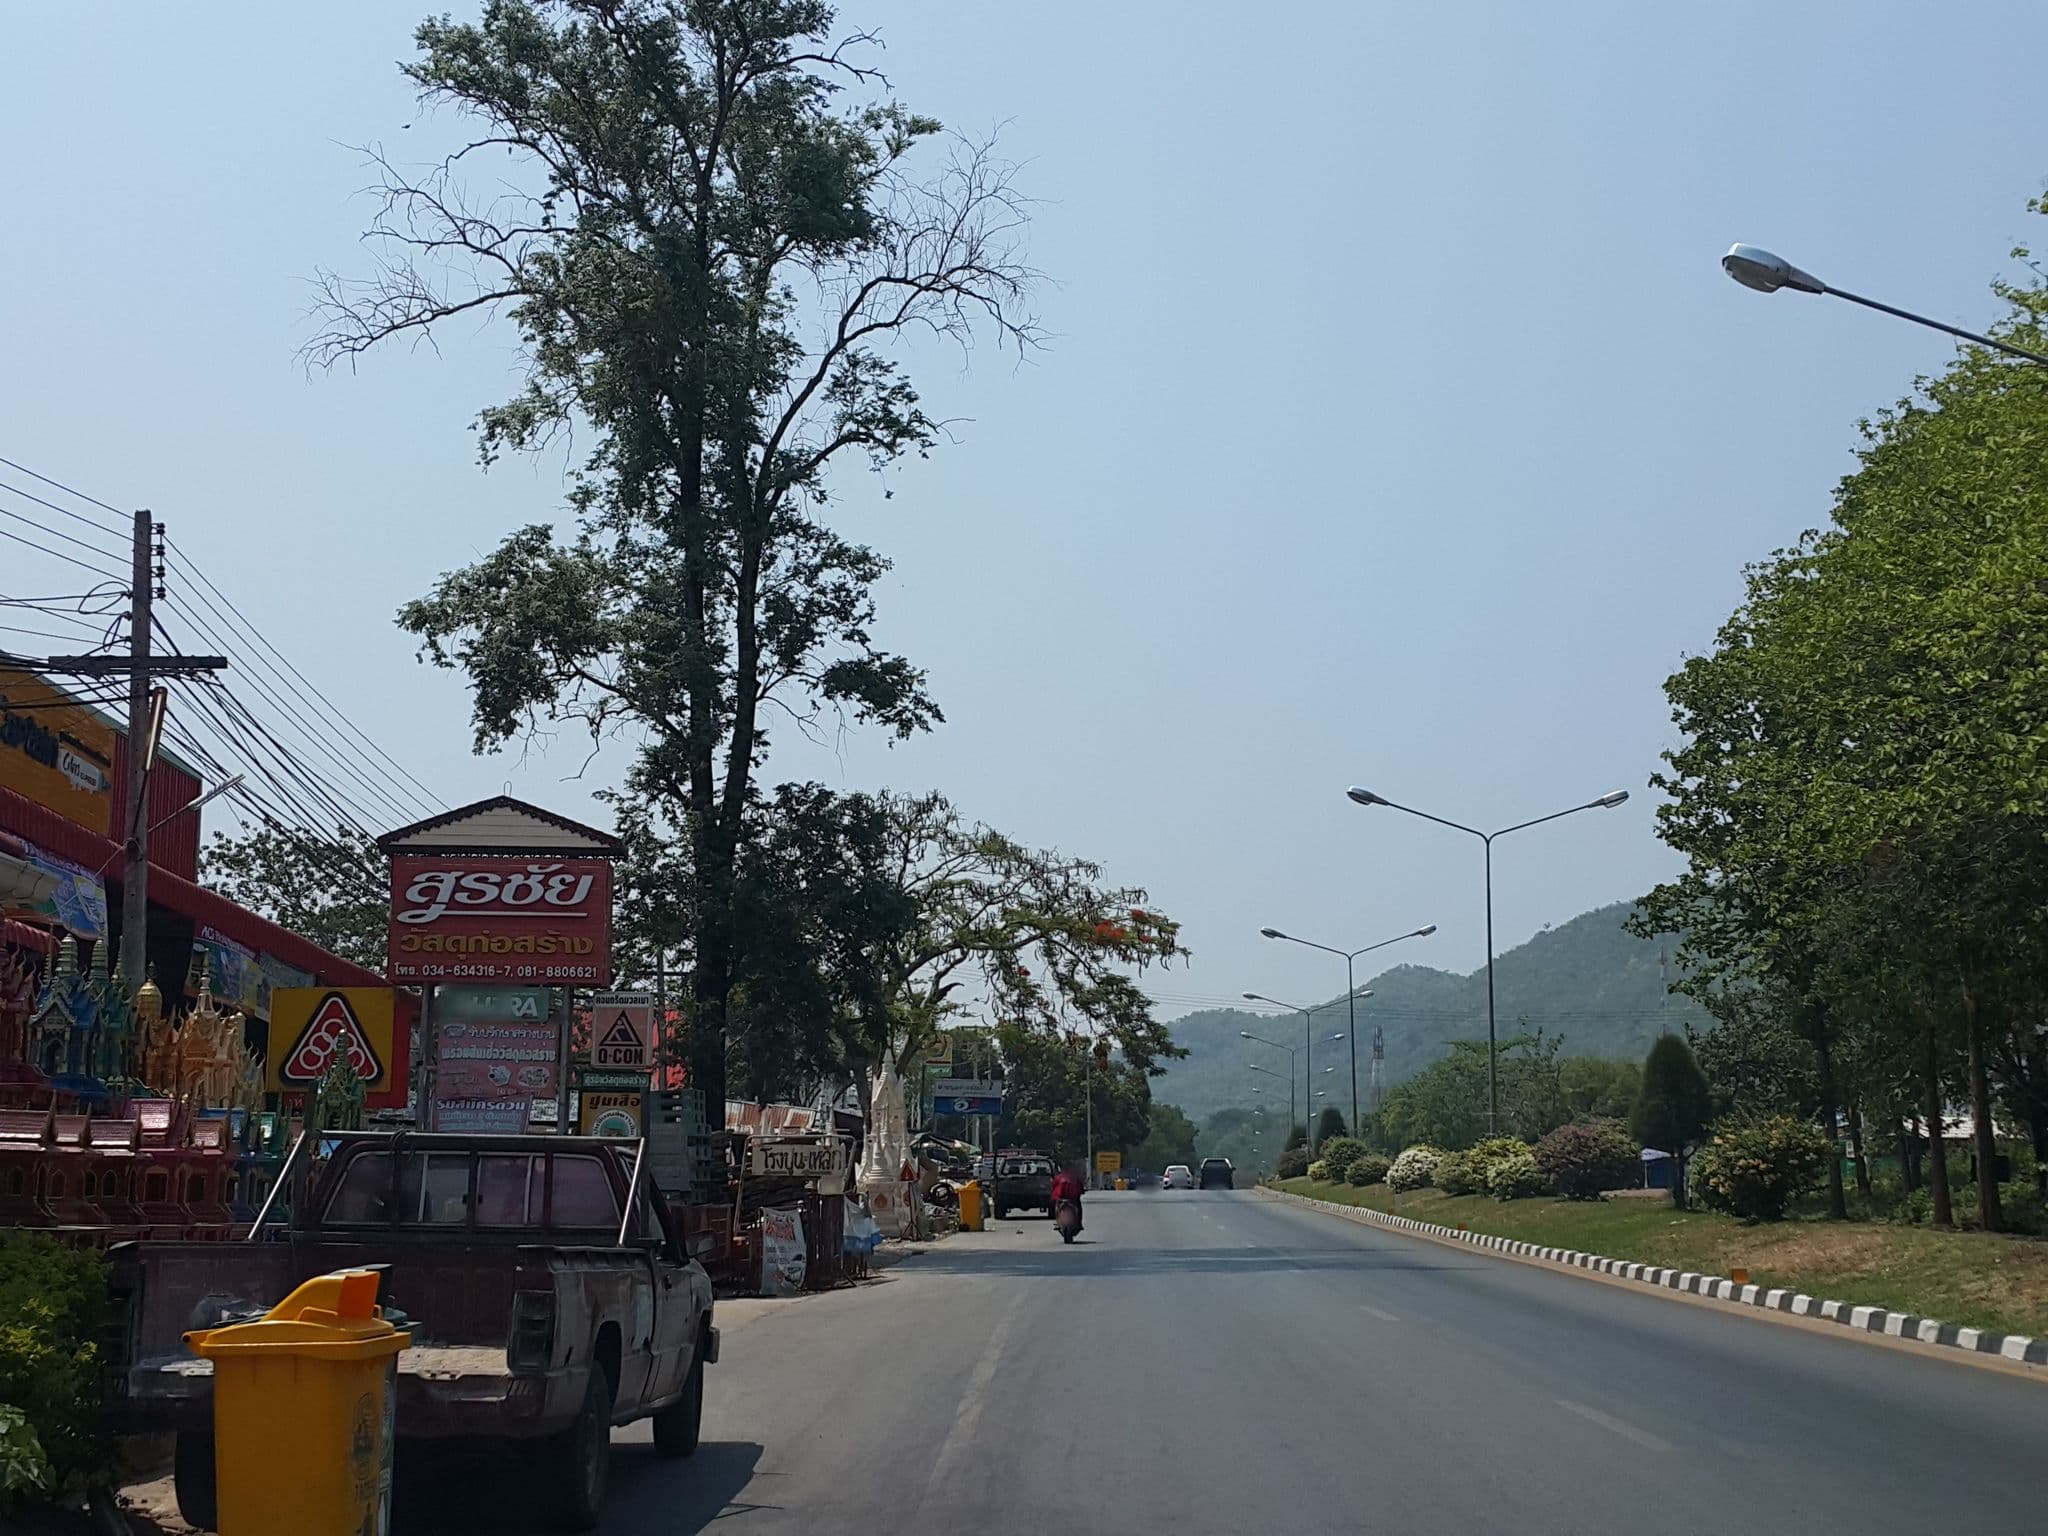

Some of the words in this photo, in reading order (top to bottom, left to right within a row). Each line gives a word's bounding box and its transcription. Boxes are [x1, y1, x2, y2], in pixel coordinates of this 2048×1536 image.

[397, 864, 595, 923] สุรชัย
[400, 927, 593, 961] วัสดุก่อสร้าง
[517, 964, 597, 978] 081-8806621
[598, 1047, 644, 1064] Q-CON
